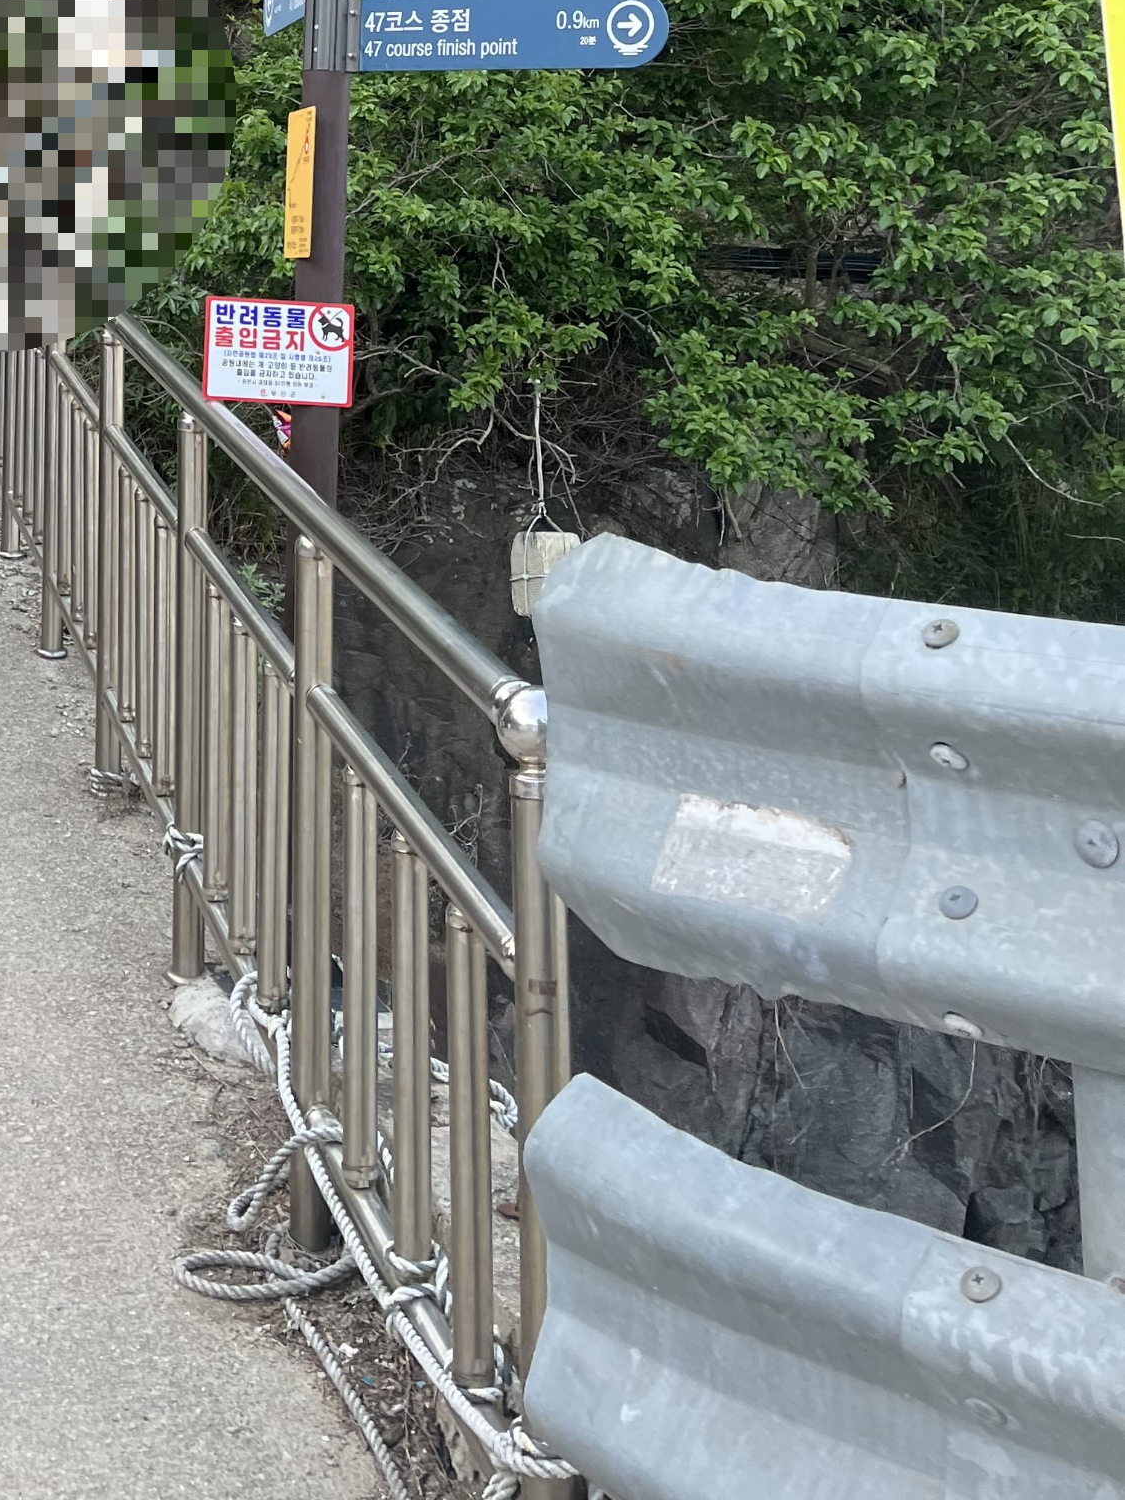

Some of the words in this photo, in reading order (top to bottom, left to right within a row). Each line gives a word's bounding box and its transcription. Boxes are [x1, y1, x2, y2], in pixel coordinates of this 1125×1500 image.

[365, 10, 424, 33] 47코스
[430, 8, 470, 34] 종점
[556, 10, 600, 30] 0.9km
[364, 40, 382, 57] 47
[386, 41, 433, 58] course
[437, 38, 476, 56] finish
[480, 38, 518, 59] point
[216, 303, 306, 330] 반려동물
[214, 326, 305, 352] 출입금지
